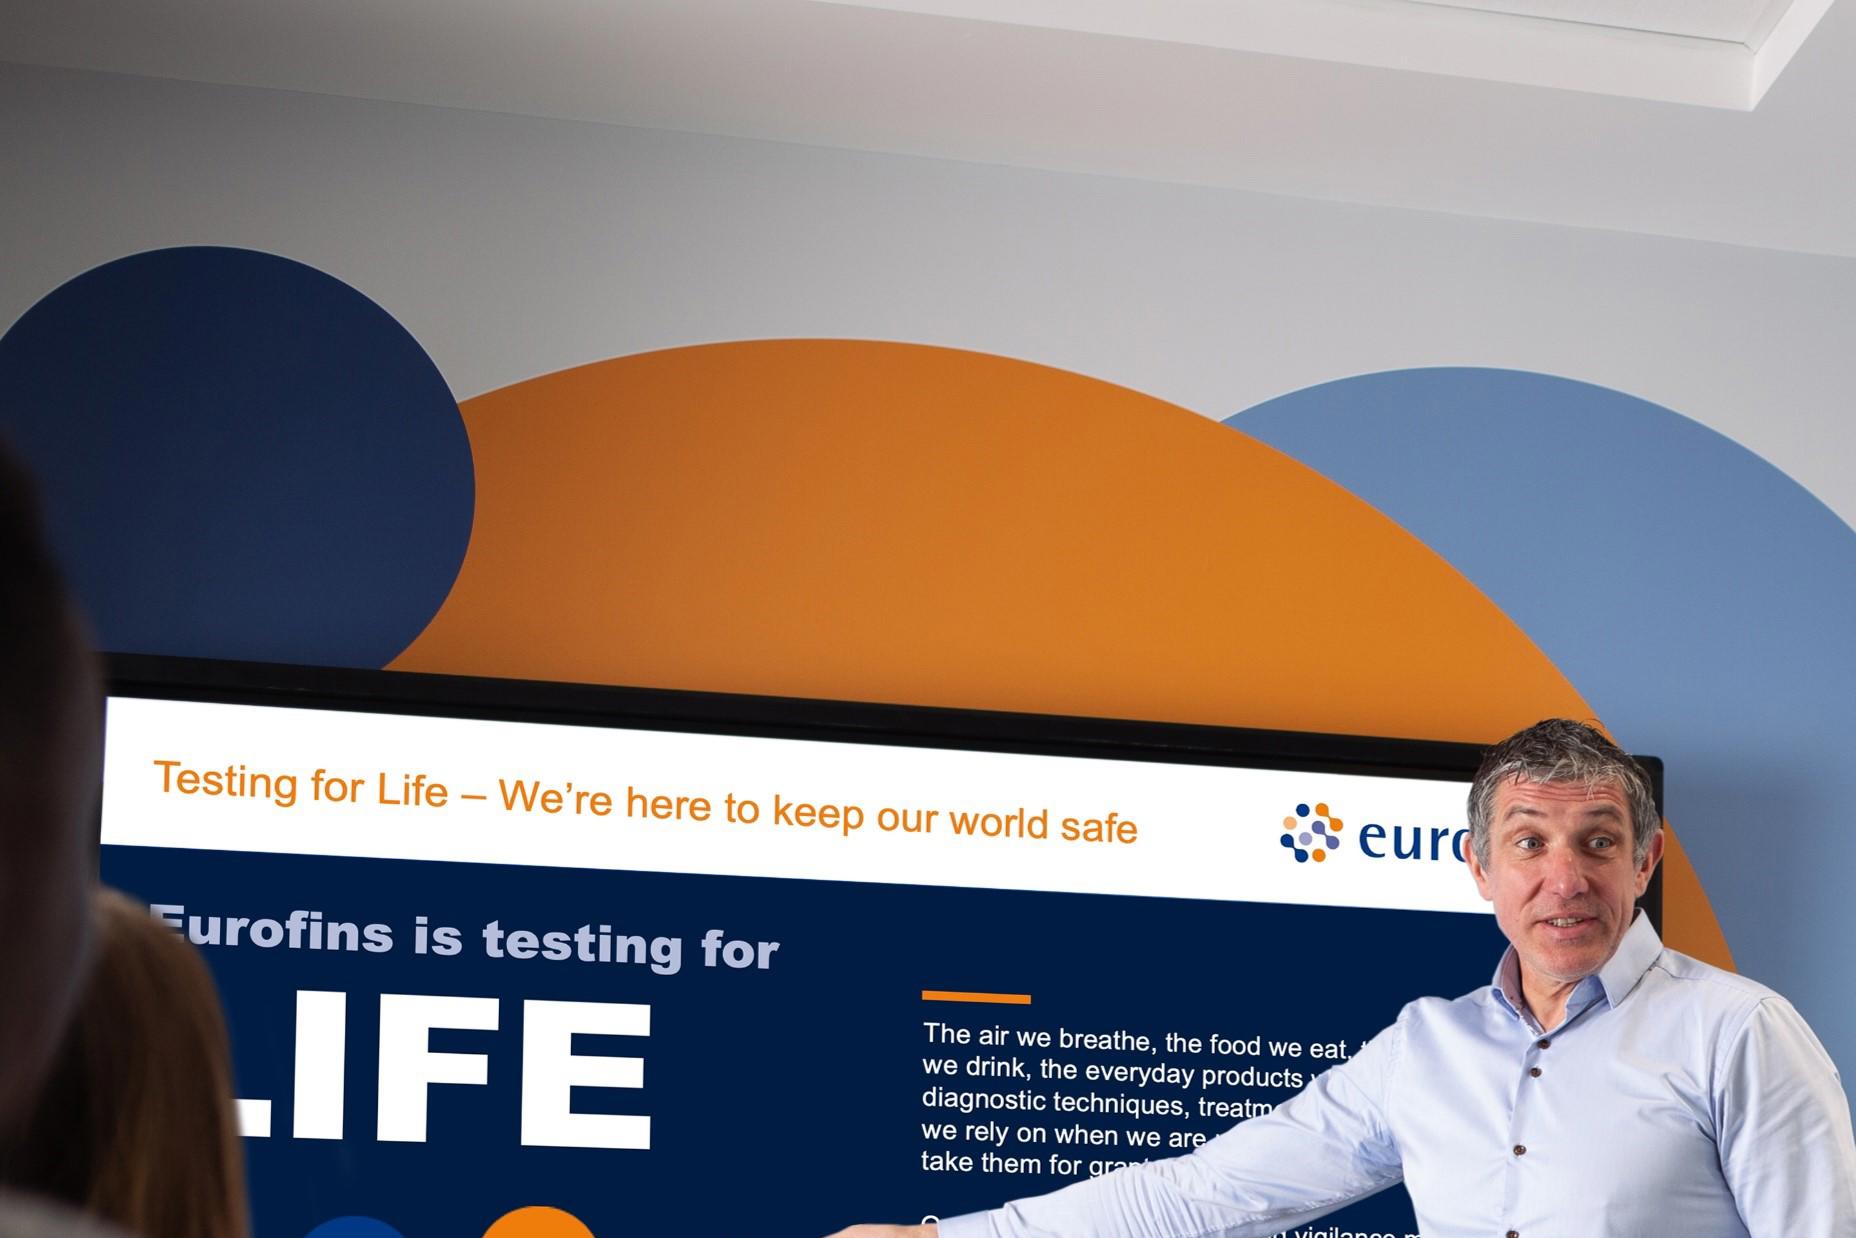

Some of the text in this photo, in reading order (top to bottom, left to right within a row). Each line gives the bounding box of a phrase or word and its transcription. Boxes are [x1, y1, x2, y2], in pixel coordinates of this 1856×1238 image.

[153, 760, 297, 808] Testing
[311, 768, 365, 803] for
[378, 772, 448, 808] Life
[499, 779, 612, 817] We’re
[627, 786, 711, 821] here
[725, 793, 759, 824] to
[774, 794, 864, 837] keep
[877, 808, 939, 832] our
[949, 808, 1048, 839] world
[1061, 812, 1137, 844] safe
[415, 916, 462, 955] is
[483, 920, 681, 975] testing
[701, 930, 780, 970] for
[923, 1022, 970, 1044] The
[979, 1025, 1009, 1045] air
[1017, 1031, 1051, 1047] we
[1060, 1028, 1157, 1055] breathe,
[1165, 1032, 1202, 1053] the
[1210, 1034, 1261, 1056] food
[1268, 1041, 1302, 1057] we
[922, 1056, 1303, 1090] we drink, the everyday products
[923, 1086, 1046, 1113] diagnostic
[1053, 1091, 1189, 1119] techniques,
[922, 1121, 1206, 1148] we rely on when we are
[921, 1151, 973, 1172] take
[981, 1152, 1041, 1174] them
[1049, 1154, 1082, 1175] for
